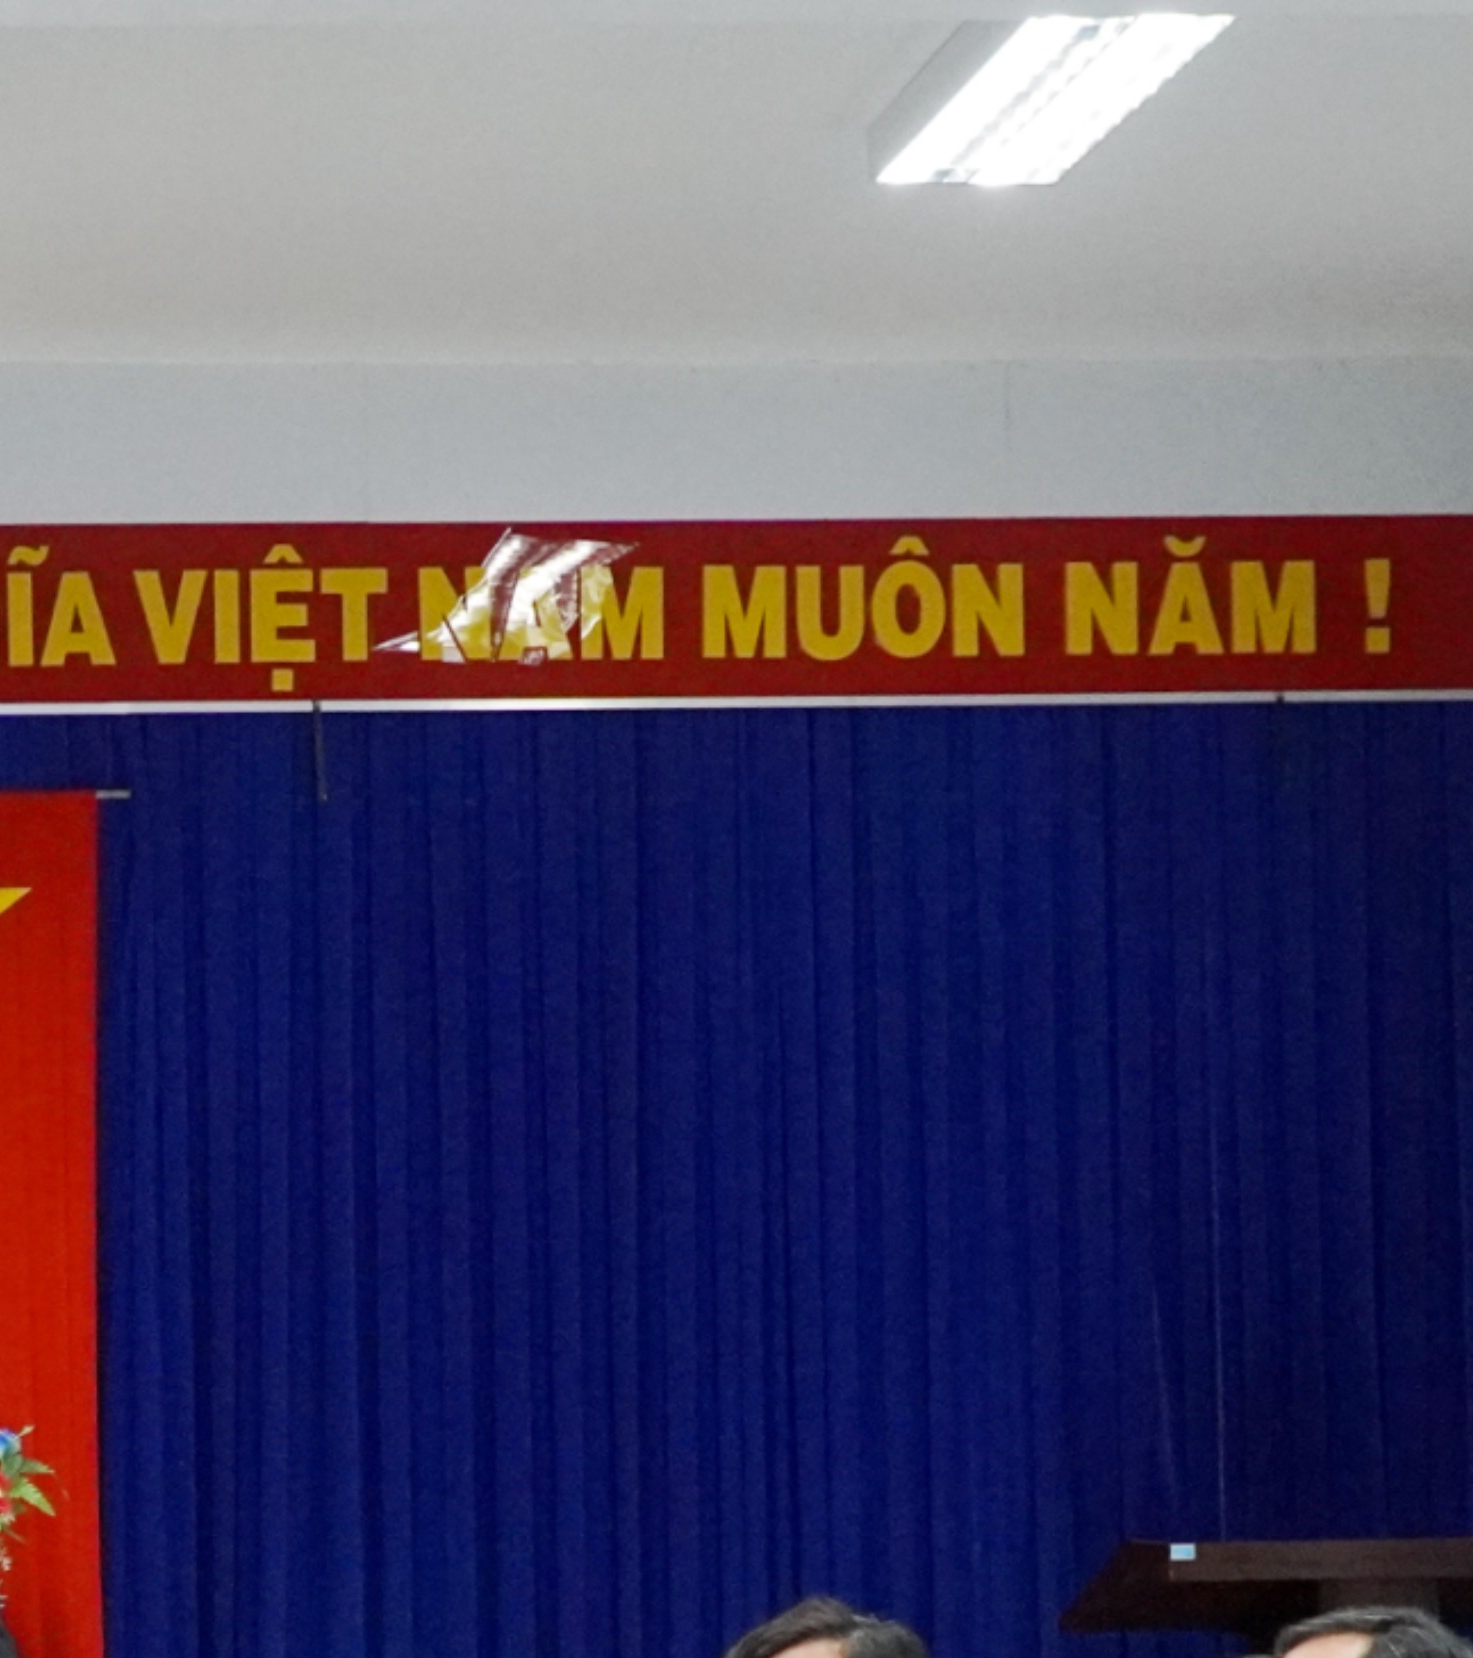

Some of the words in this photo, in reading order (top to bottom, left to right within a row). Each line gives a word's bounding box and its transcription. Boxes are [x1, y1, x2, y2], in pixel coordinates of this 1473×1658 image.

[132, 543, 388, 692] VIỆT
[416, 564, 665, 665] NAM
[702, 535, 1026, 661] MUÔN
[1064, 536, 1317, 655] NĂM
[1364, 558, 1391, 654] !
